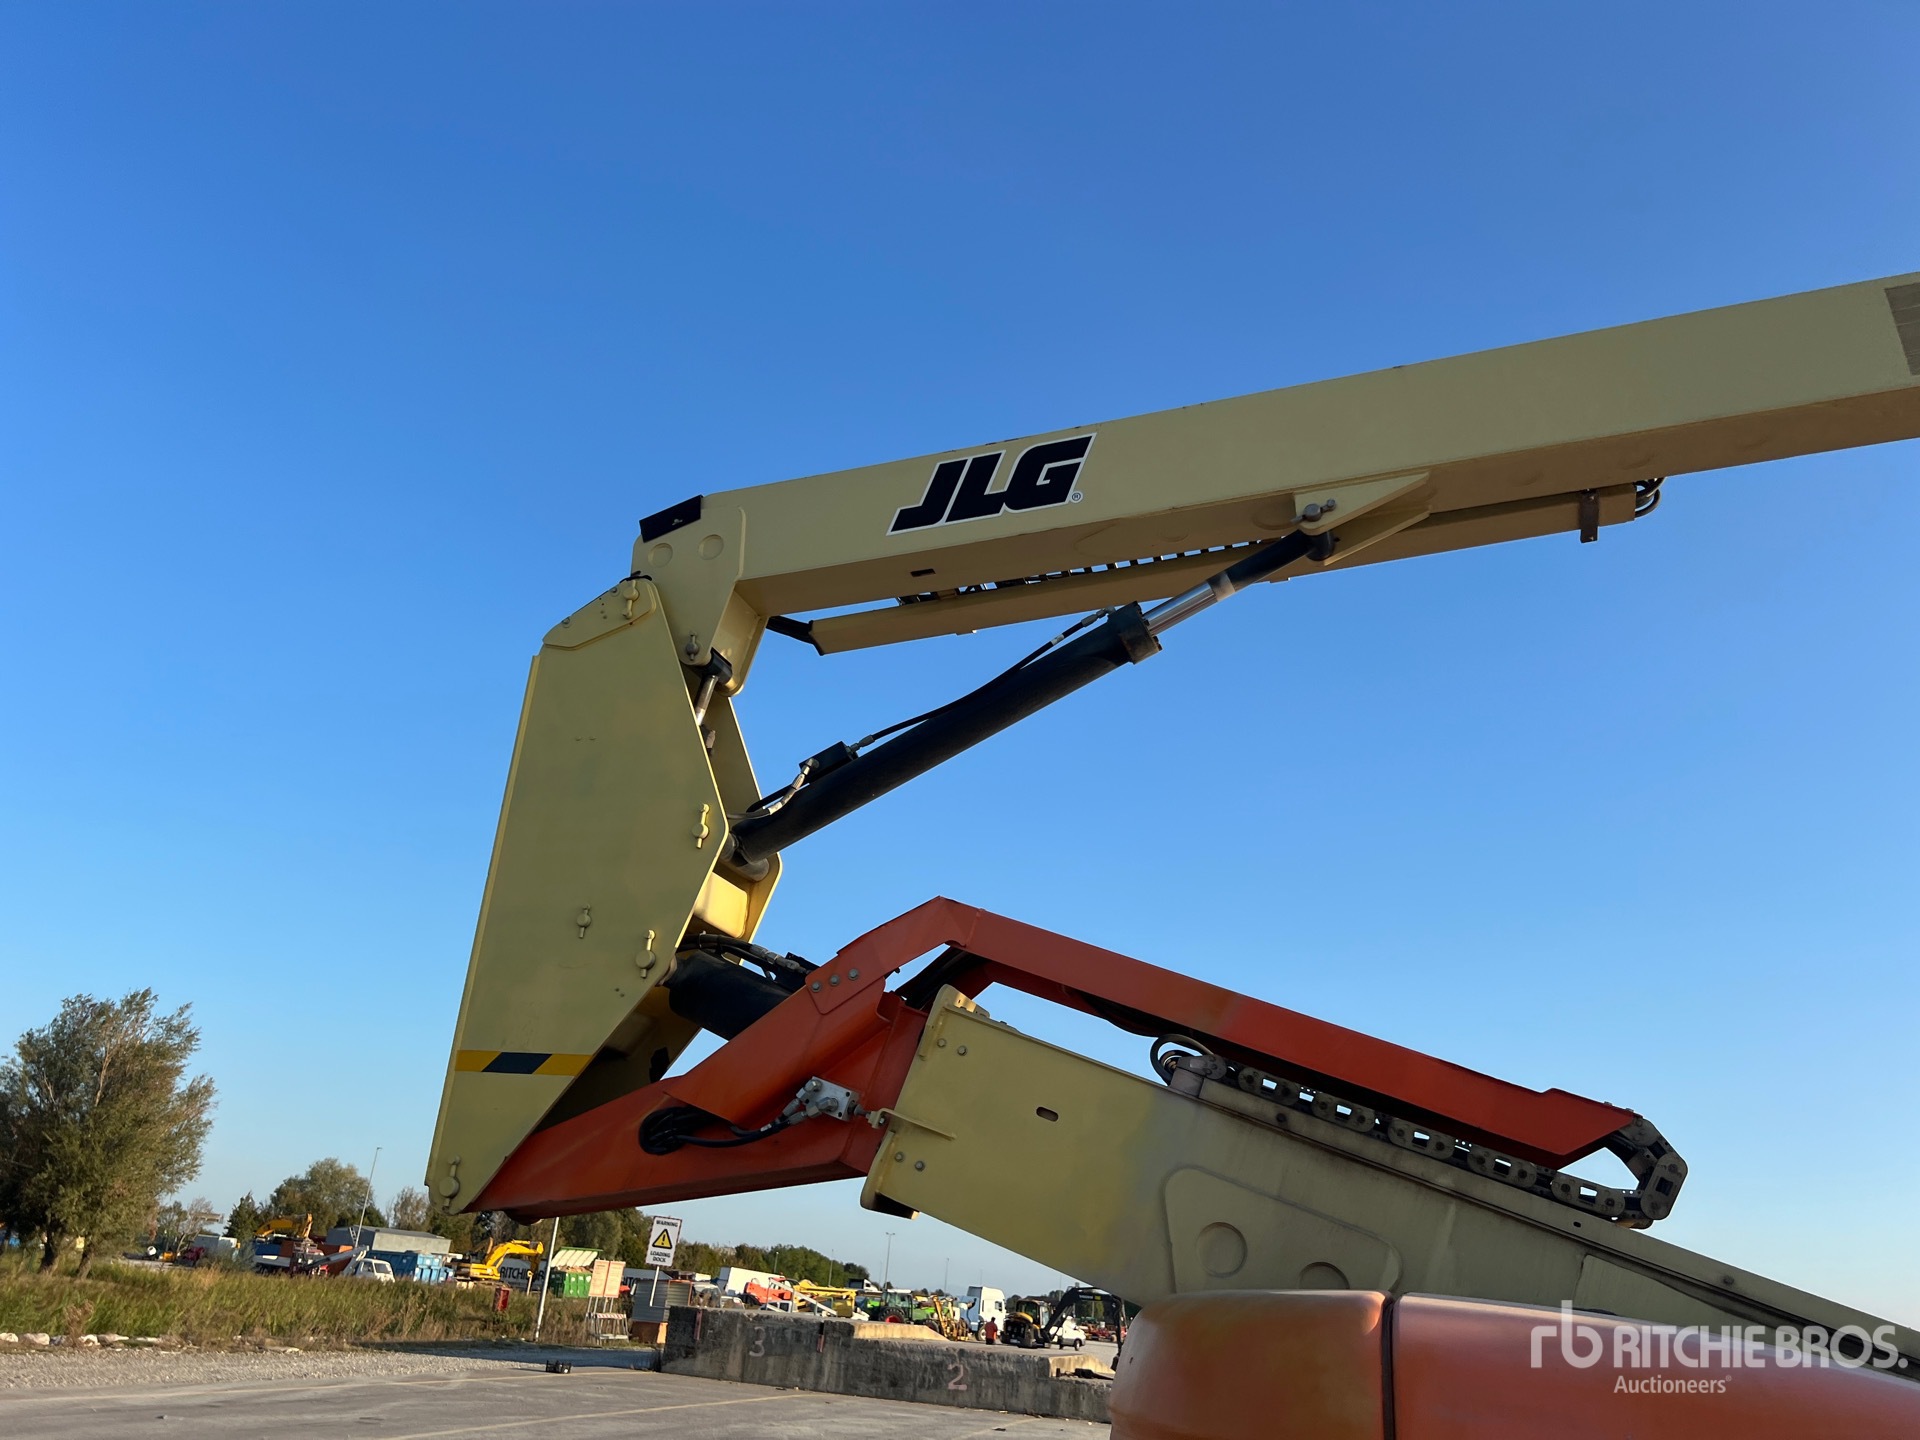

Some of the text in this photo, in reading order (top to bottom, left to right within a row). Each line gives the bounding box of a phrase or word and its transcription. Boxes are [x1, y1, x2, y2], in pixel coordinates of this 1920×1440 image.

[888, 433, 1096, 534] JLG
[656, 1220, 679, 1228] WARNING
[650, 1250, 671, 1258] LOADING
[500, 1266, 533, 1281] RITCHI
[749, 1326, 766, 1358] 3
[947, 1363, 968, 1391] 2
